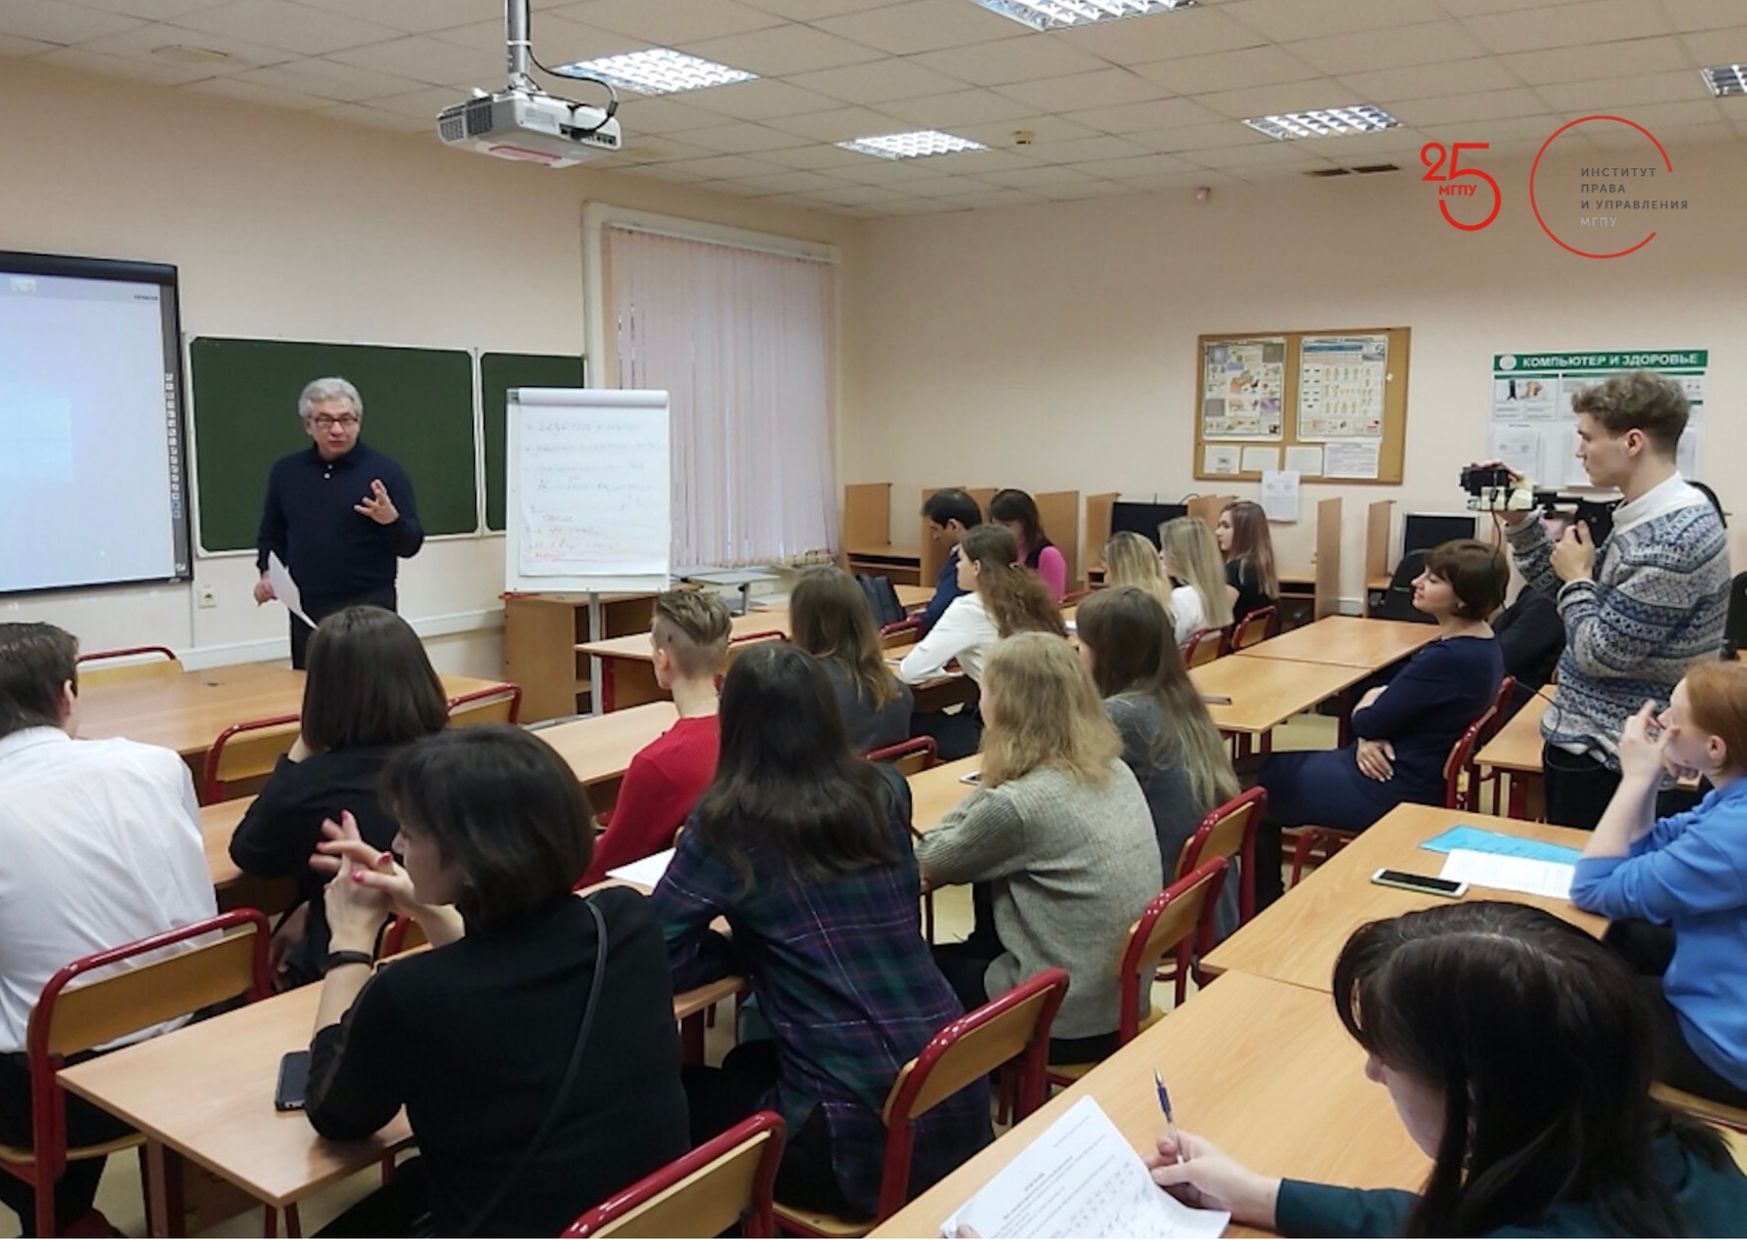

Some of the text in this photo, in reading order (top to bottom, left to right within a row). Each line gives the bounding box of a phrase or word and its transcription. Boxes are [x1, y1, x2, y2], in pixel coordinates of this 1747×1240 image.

[1522, 353, 1699, 368] КОМПЬЮТЕР И ЗДОРОВЬЕ
